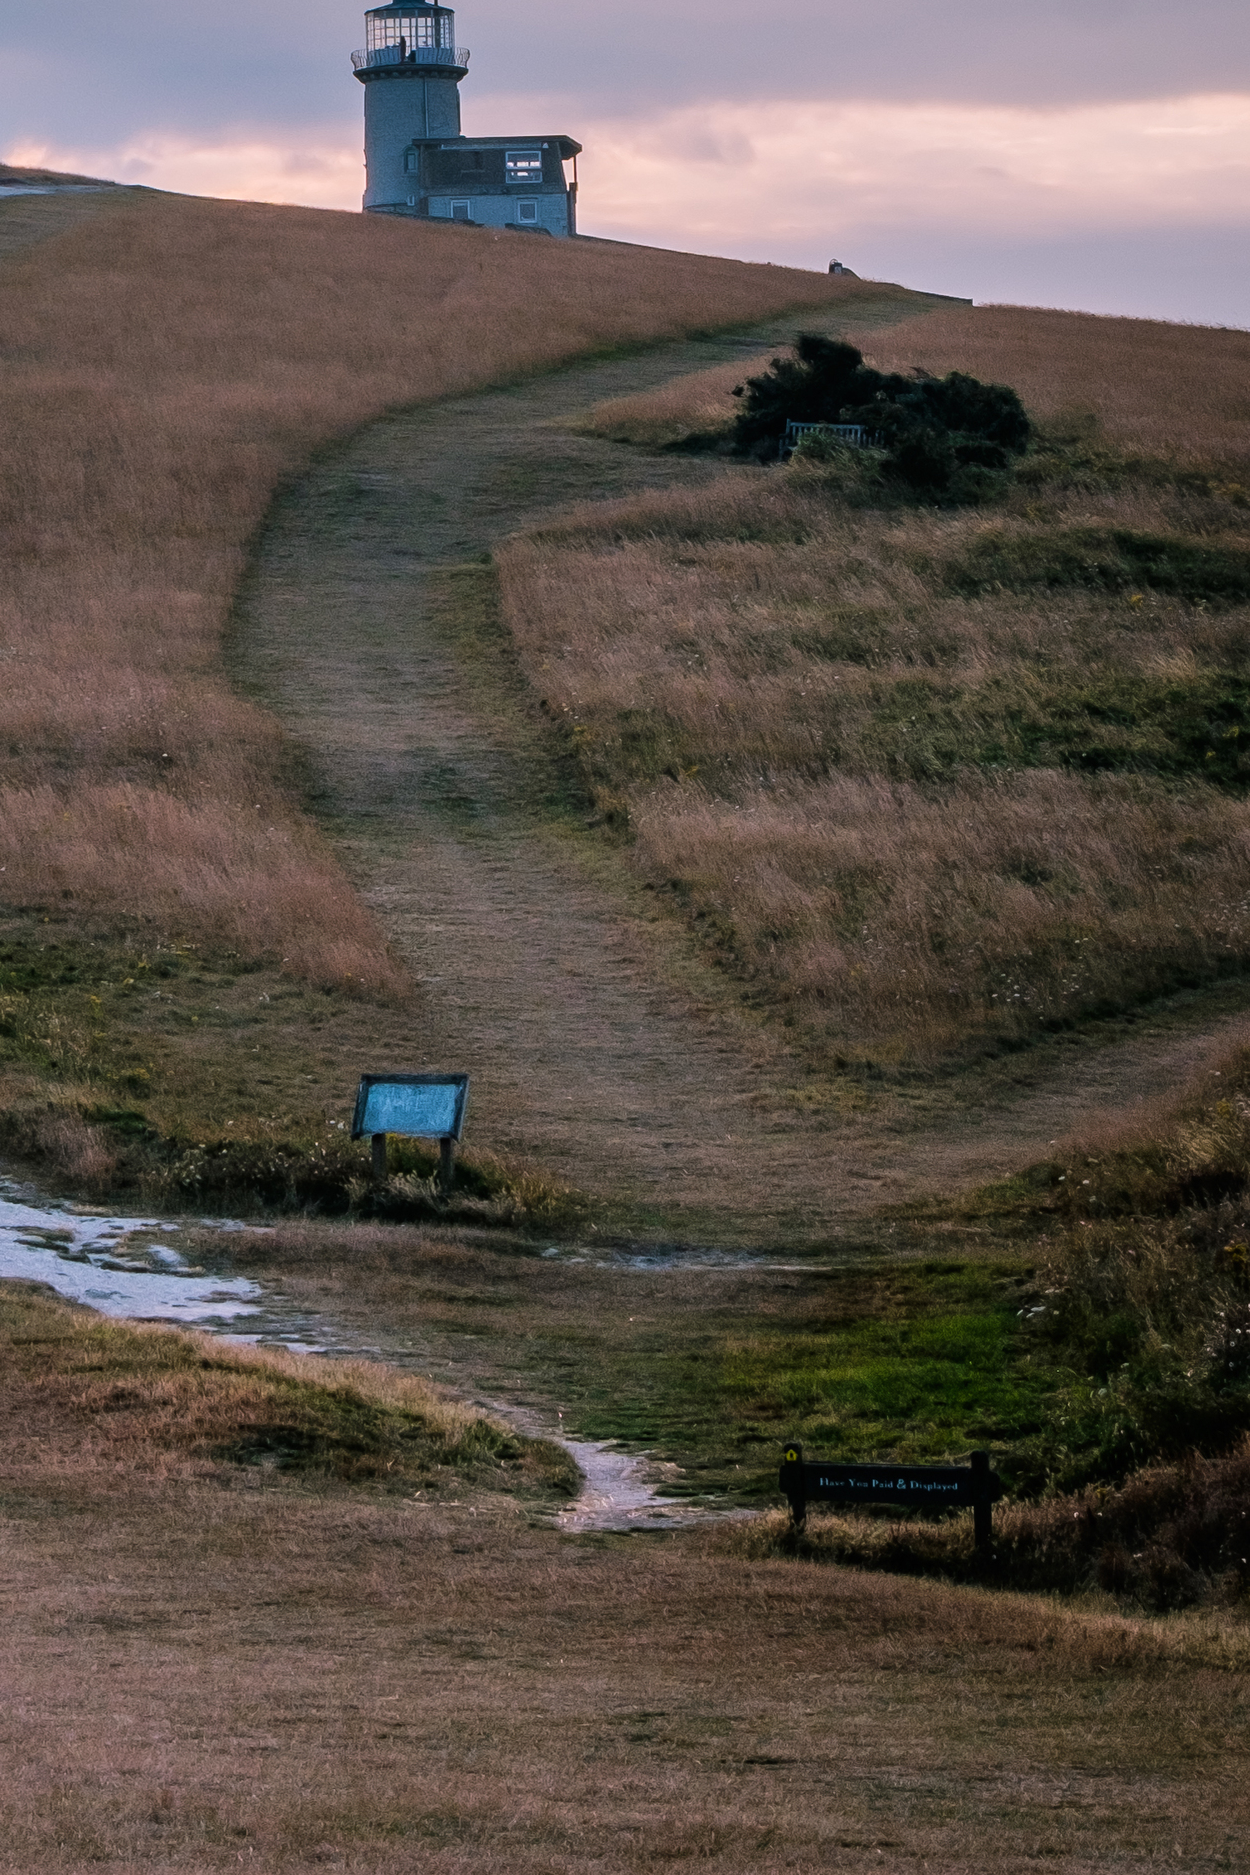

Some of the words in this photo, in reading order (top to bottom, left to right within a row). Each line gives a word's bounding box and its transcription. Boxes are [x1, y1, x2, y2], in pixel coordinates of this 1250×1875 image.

[819, 1477, 845, 1486] Have
[848, 1478, 868, 1487] You
[872, 1479, 893, 1488] Paid
[896, 1478, 907, 1490] &
[910, 1480, 958, 1492] Displayed
